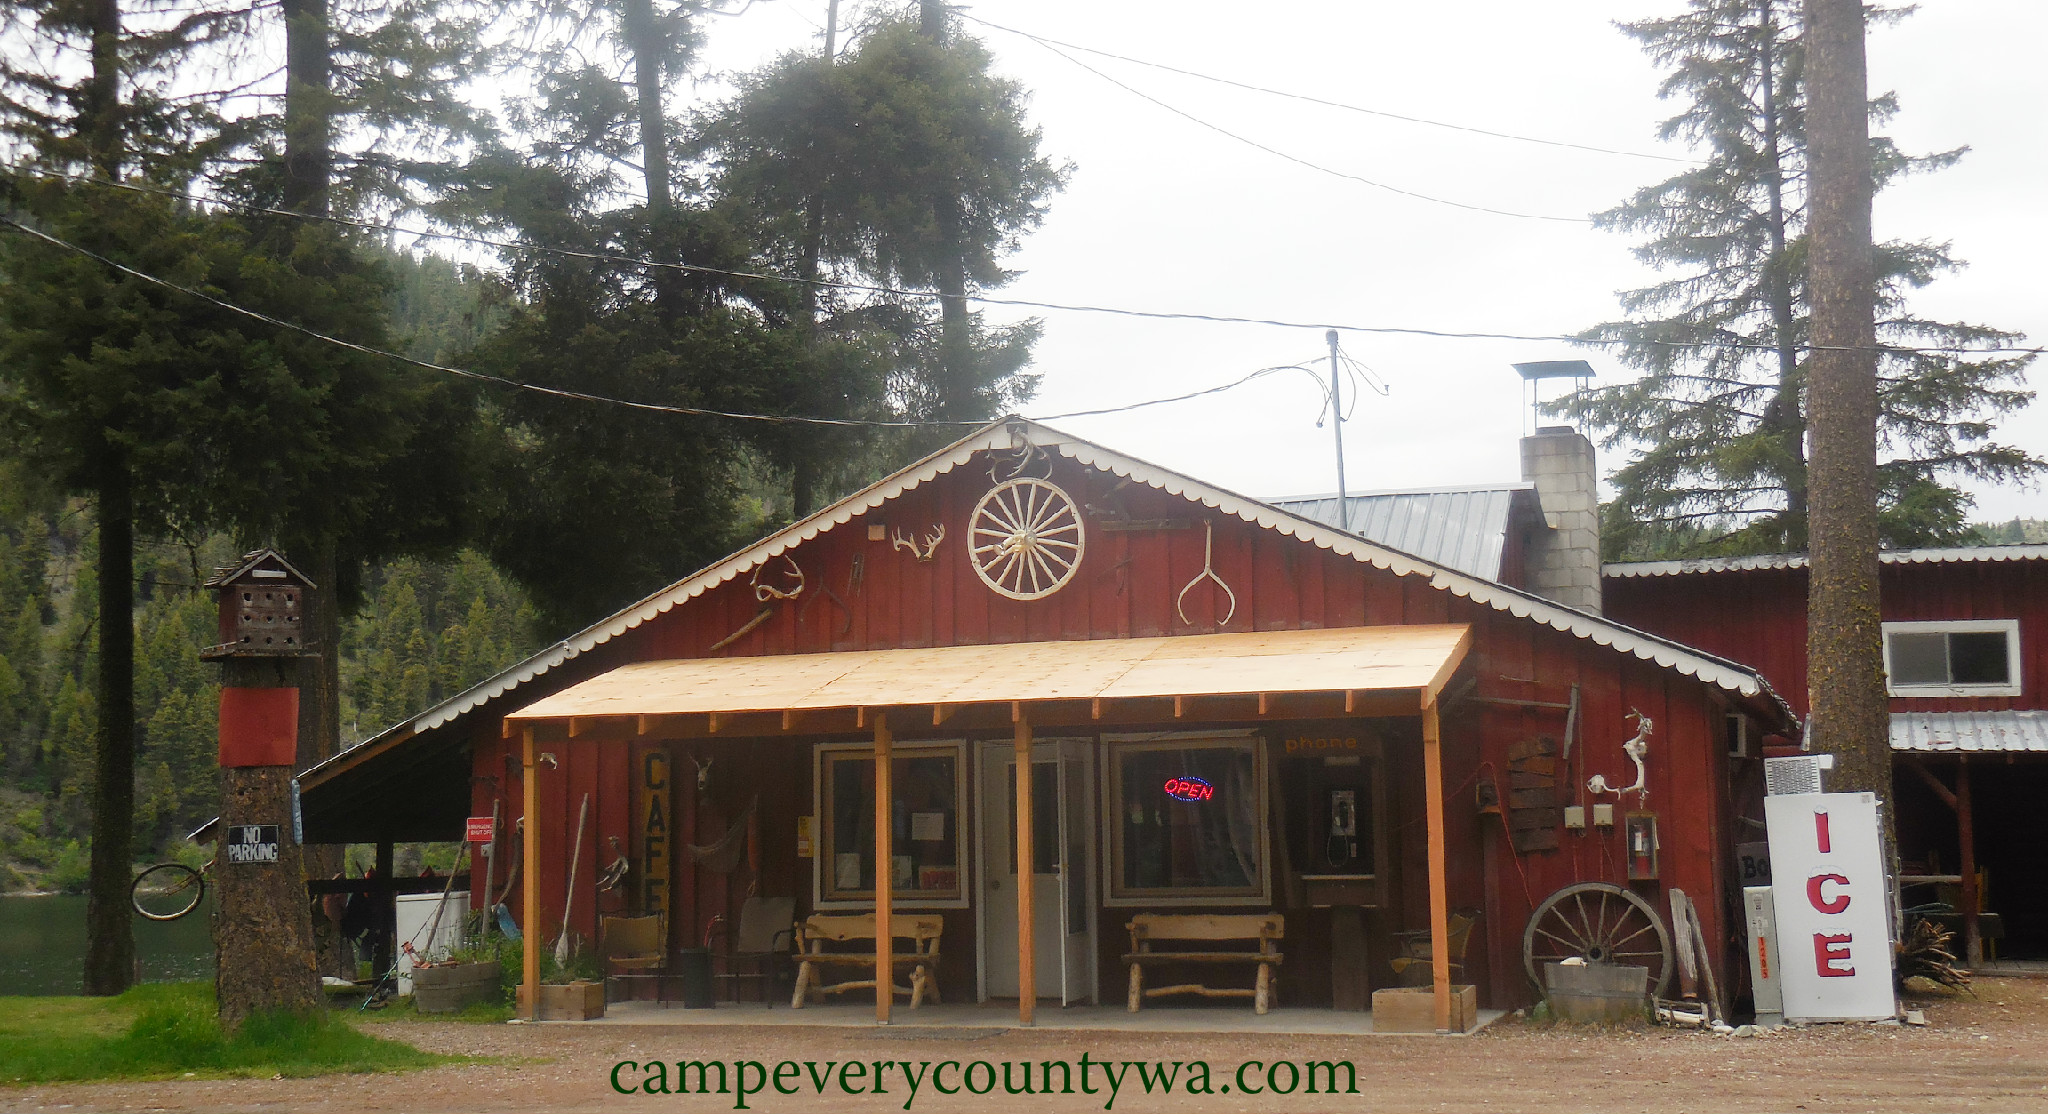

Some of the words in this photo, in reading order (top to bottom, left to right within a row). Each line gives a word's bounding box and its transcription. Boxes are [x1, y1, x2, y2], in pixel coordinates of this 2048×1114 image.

[1285, 736, 1357, 753] phone
[1164, 778, 1214, 800] OPEN
[243, 826, 261, 844] NO
[645, 752, 667, 916] CAFE
[228, 843, 278, 861] PARKING
[1806, 806, 1856, 977] ICE
